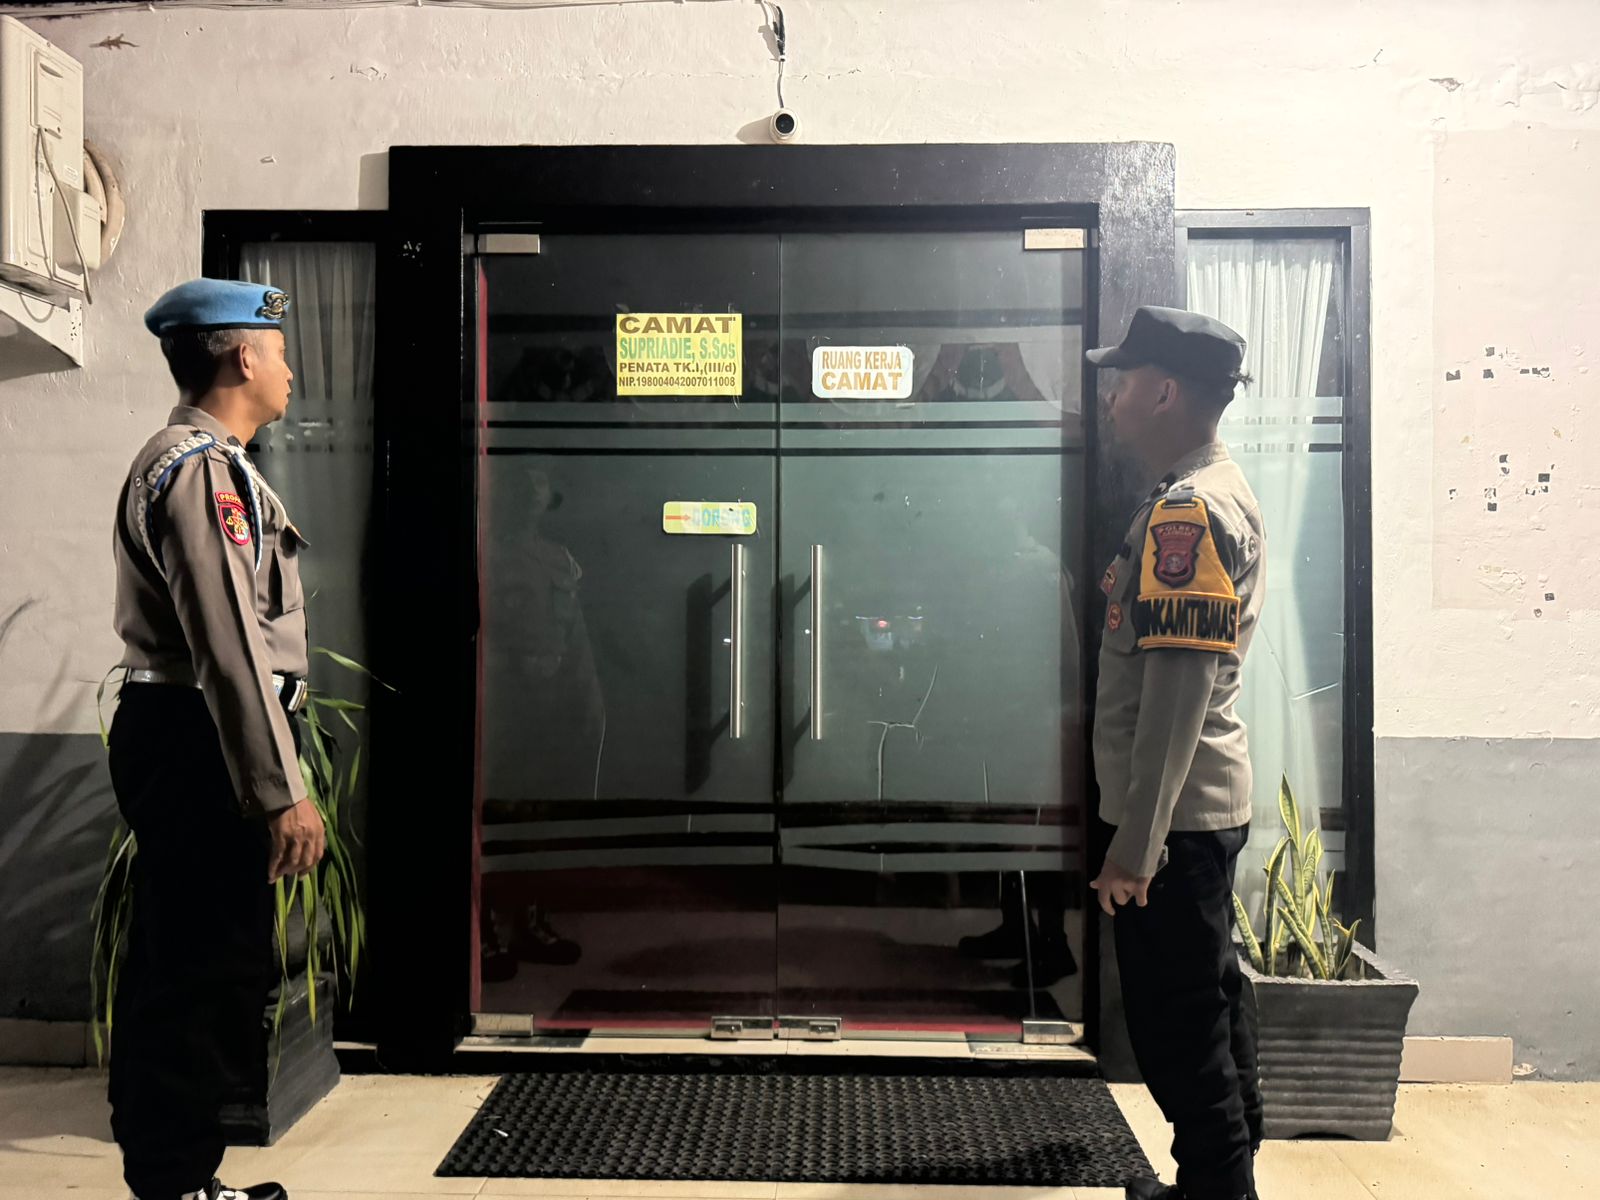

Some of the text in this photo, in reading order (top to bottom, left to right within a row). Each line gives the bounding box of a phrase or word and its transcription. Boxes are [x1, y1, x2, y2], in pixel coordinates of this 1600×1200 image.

[619, 316, 736, 334] CAMAT
[620, 337, 736, 363] SUPRIADIE, S.Sos
[619, 362, 670, 373] PENATA
[822, 351, 902, 370] RUANG KERJA
[821, 371, 903, 391] CAMAT
